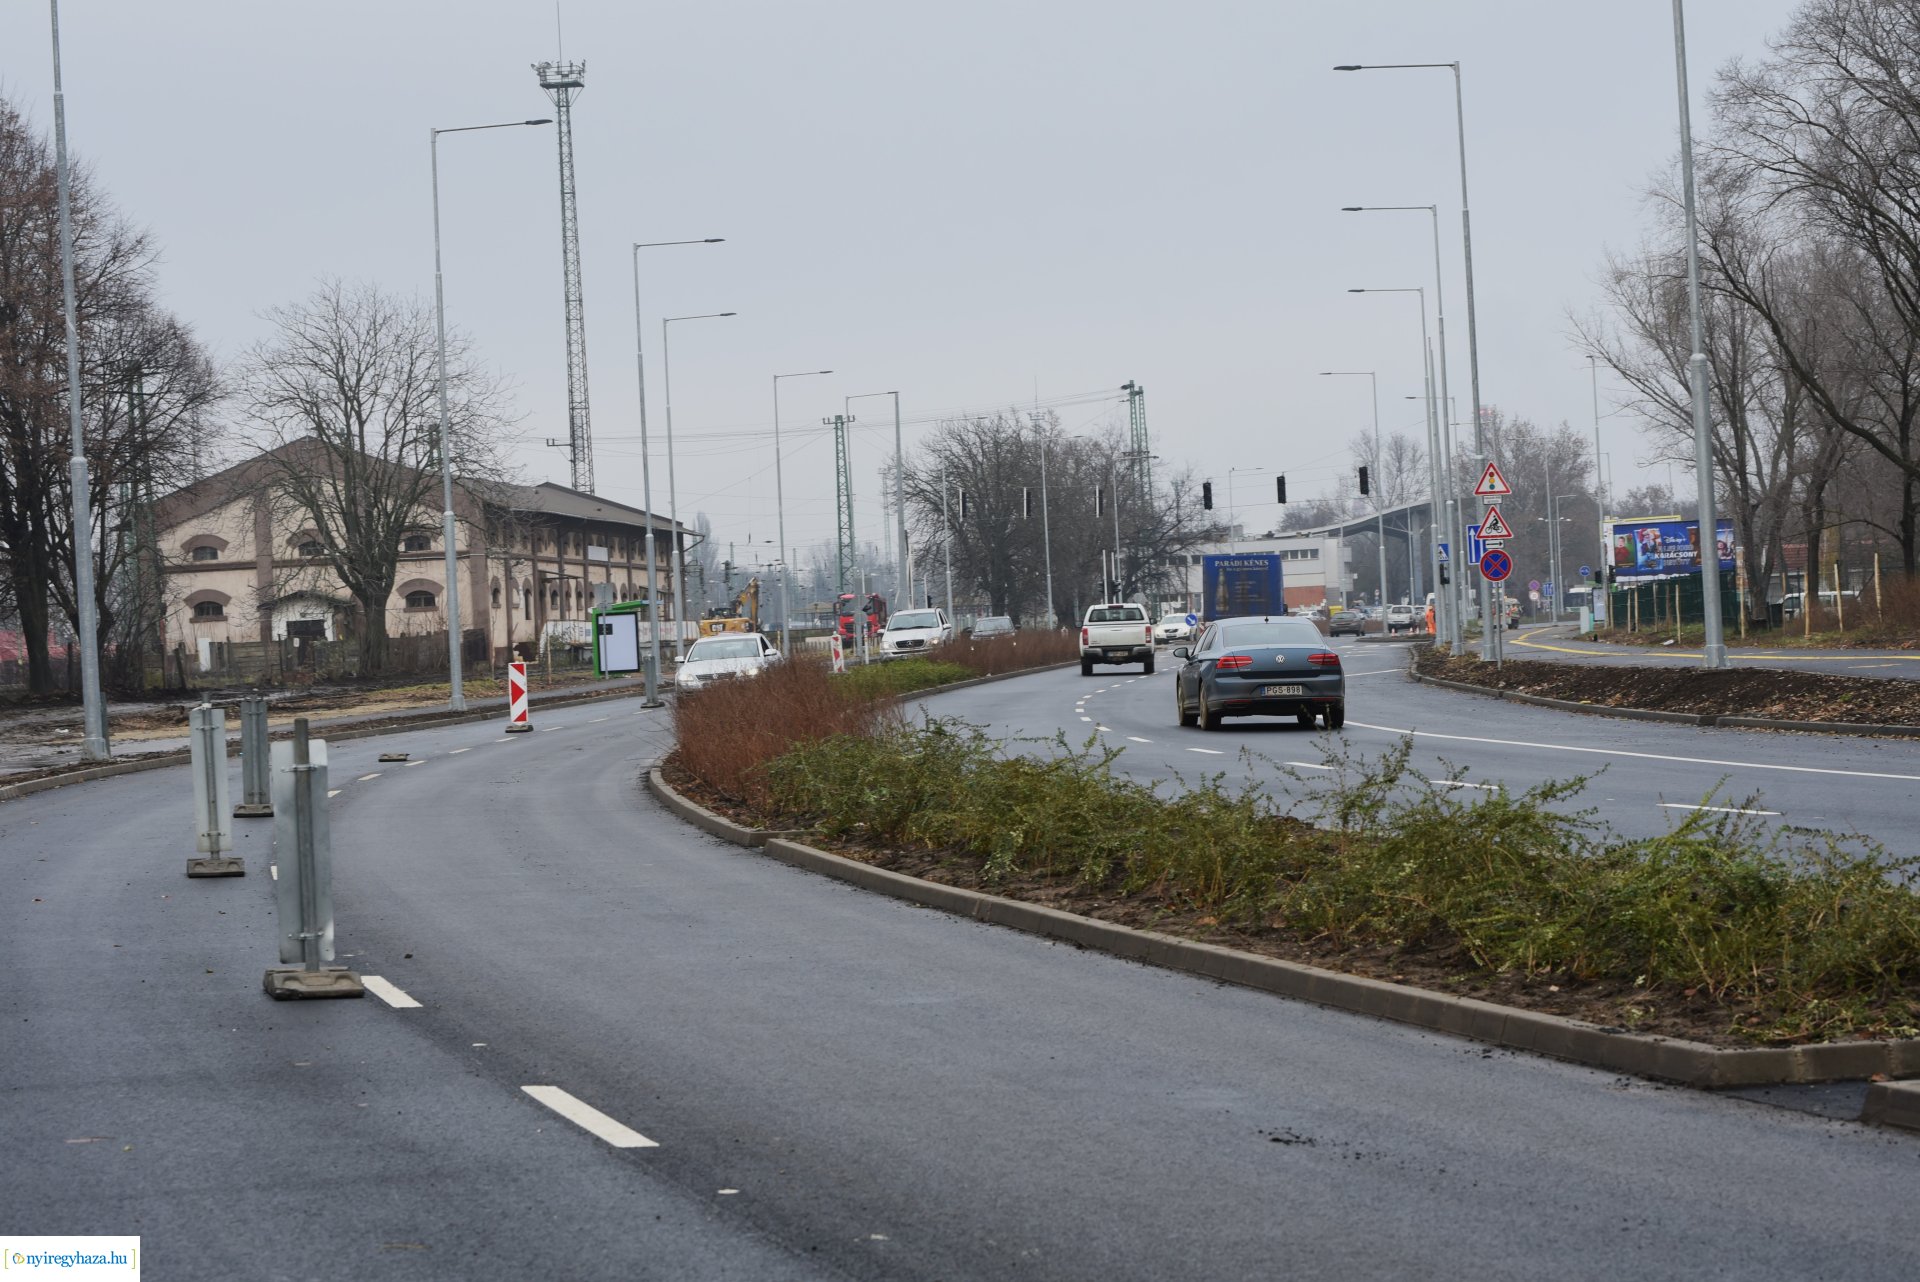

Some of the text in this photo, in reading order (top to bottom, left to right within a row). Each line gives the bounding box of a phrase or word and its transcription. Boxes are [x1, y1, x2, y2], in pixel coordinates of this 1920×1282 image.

[1654, 550, 1698, 559] KARÁCSONY
[1214, 558, 1269, 567] PARÁDI KÉNES
[1266, 686, 1301, 694] PGS-898
